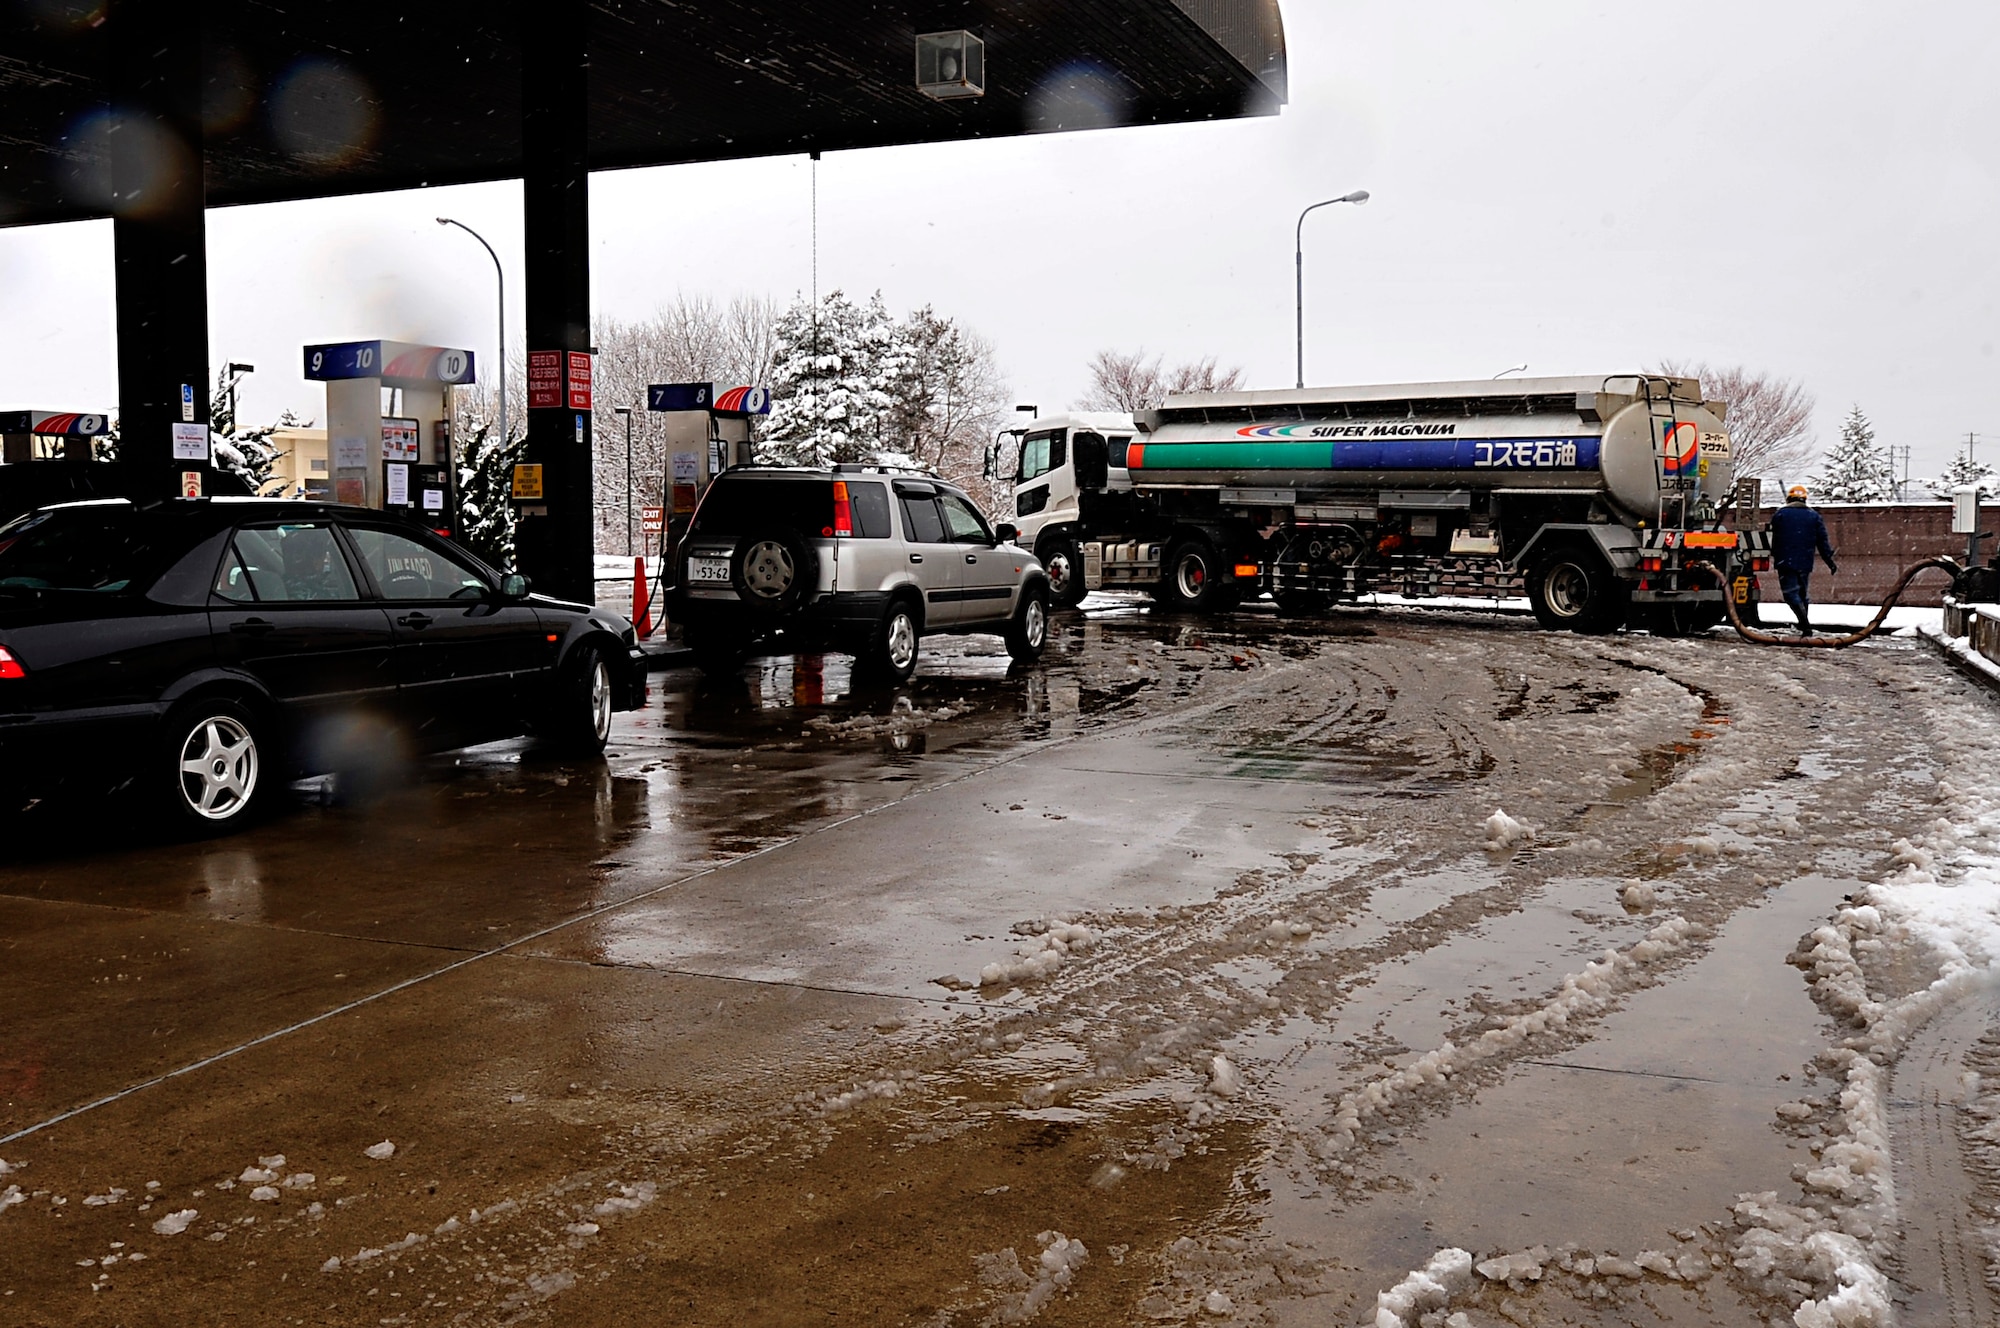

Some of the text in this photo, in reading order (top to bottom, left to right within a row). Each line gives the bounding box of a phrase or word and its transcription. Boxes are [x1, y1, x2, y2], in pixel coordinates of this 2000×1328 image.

[311, 347, 373, 372] 9 10
[446, 356, 460, 375] 10
[654, 388, 706, 406] 7 8
[752, 393, 759, 407] 8
[20, 415, 27, 428] 2
[85, 418, 94, 430] 2
[1309, 423, 1456, 438] SUPER MAGNUM
[1473, 439, 1577, 467] コスモ石油
[1700, 442, 1728, 452] マグナム
[642, 510, 660, 519] EXIT
[642, 521, 662, 530] ONLY
[1733, 575, 1749, 604] 危
